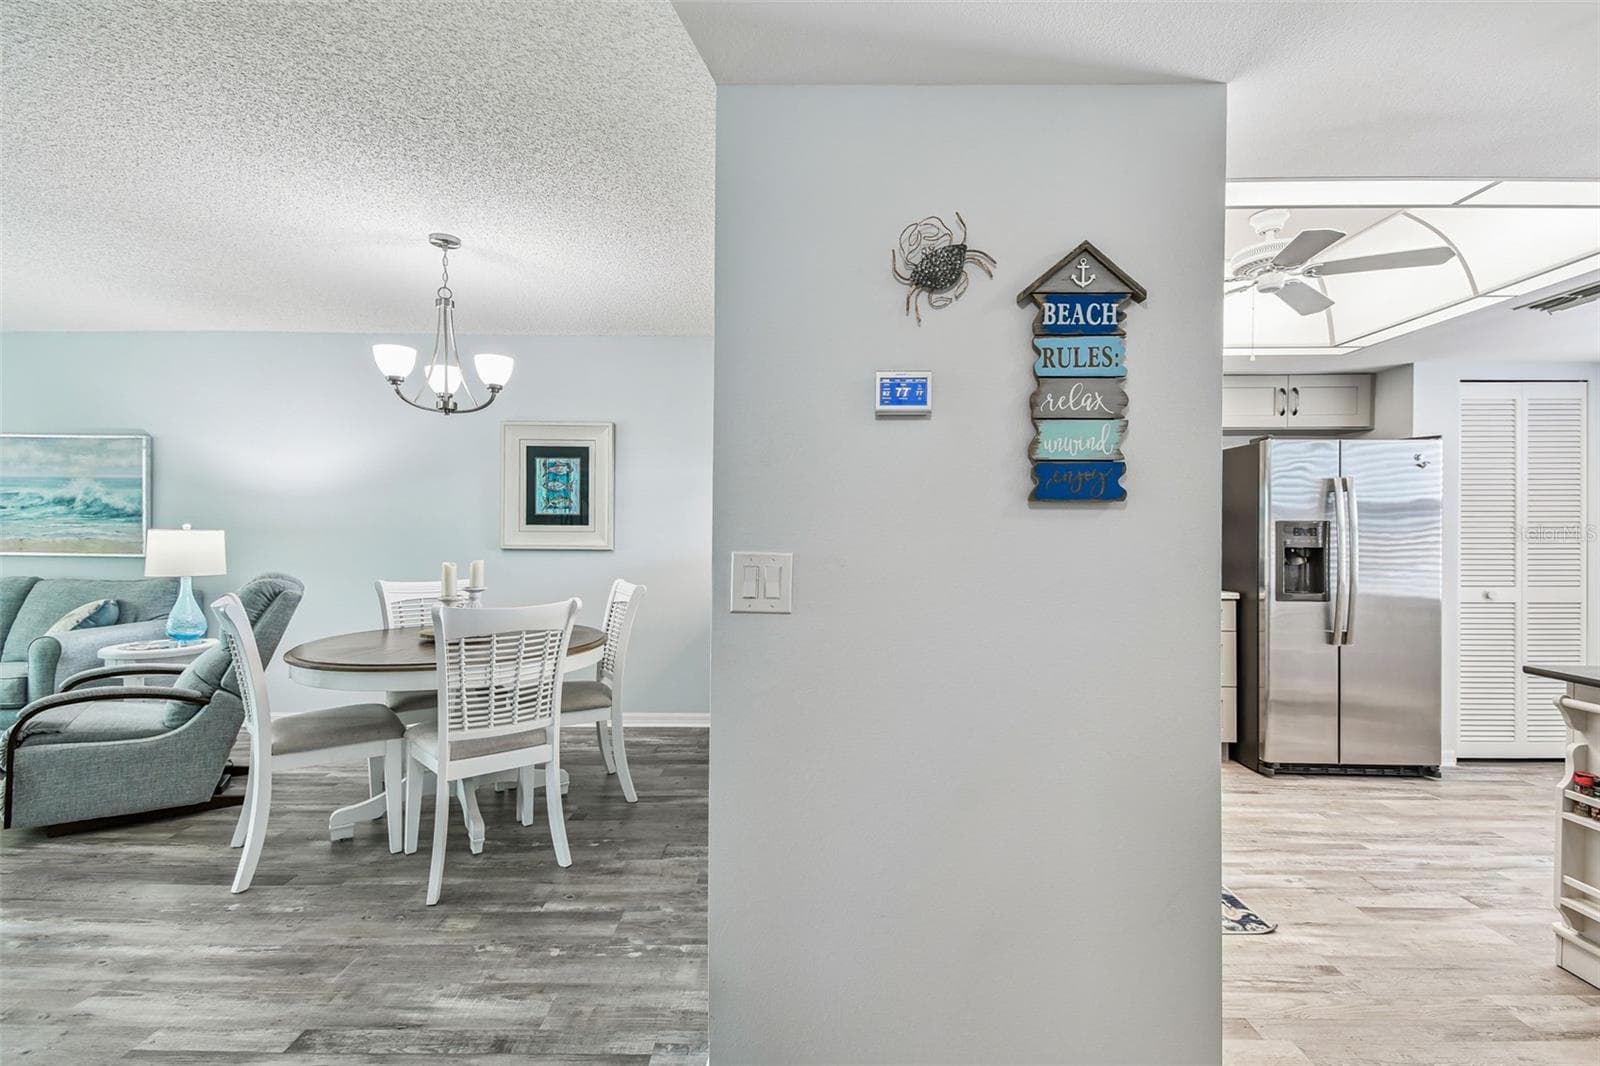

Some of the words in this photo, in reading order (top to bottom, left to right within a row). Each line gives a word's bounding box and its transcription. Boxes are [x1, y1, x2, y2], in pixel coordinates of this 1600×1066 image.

[1042, 302, 1119, 325] BEACH
[1041, 346, 1119, 368] RULES:
[895, 387, 911, 397] 77
[1040, 382, 1115, 414] relax
[1043, 423, 1114, 456] unwind
[1046, 468, 1113, 497] enjoy
